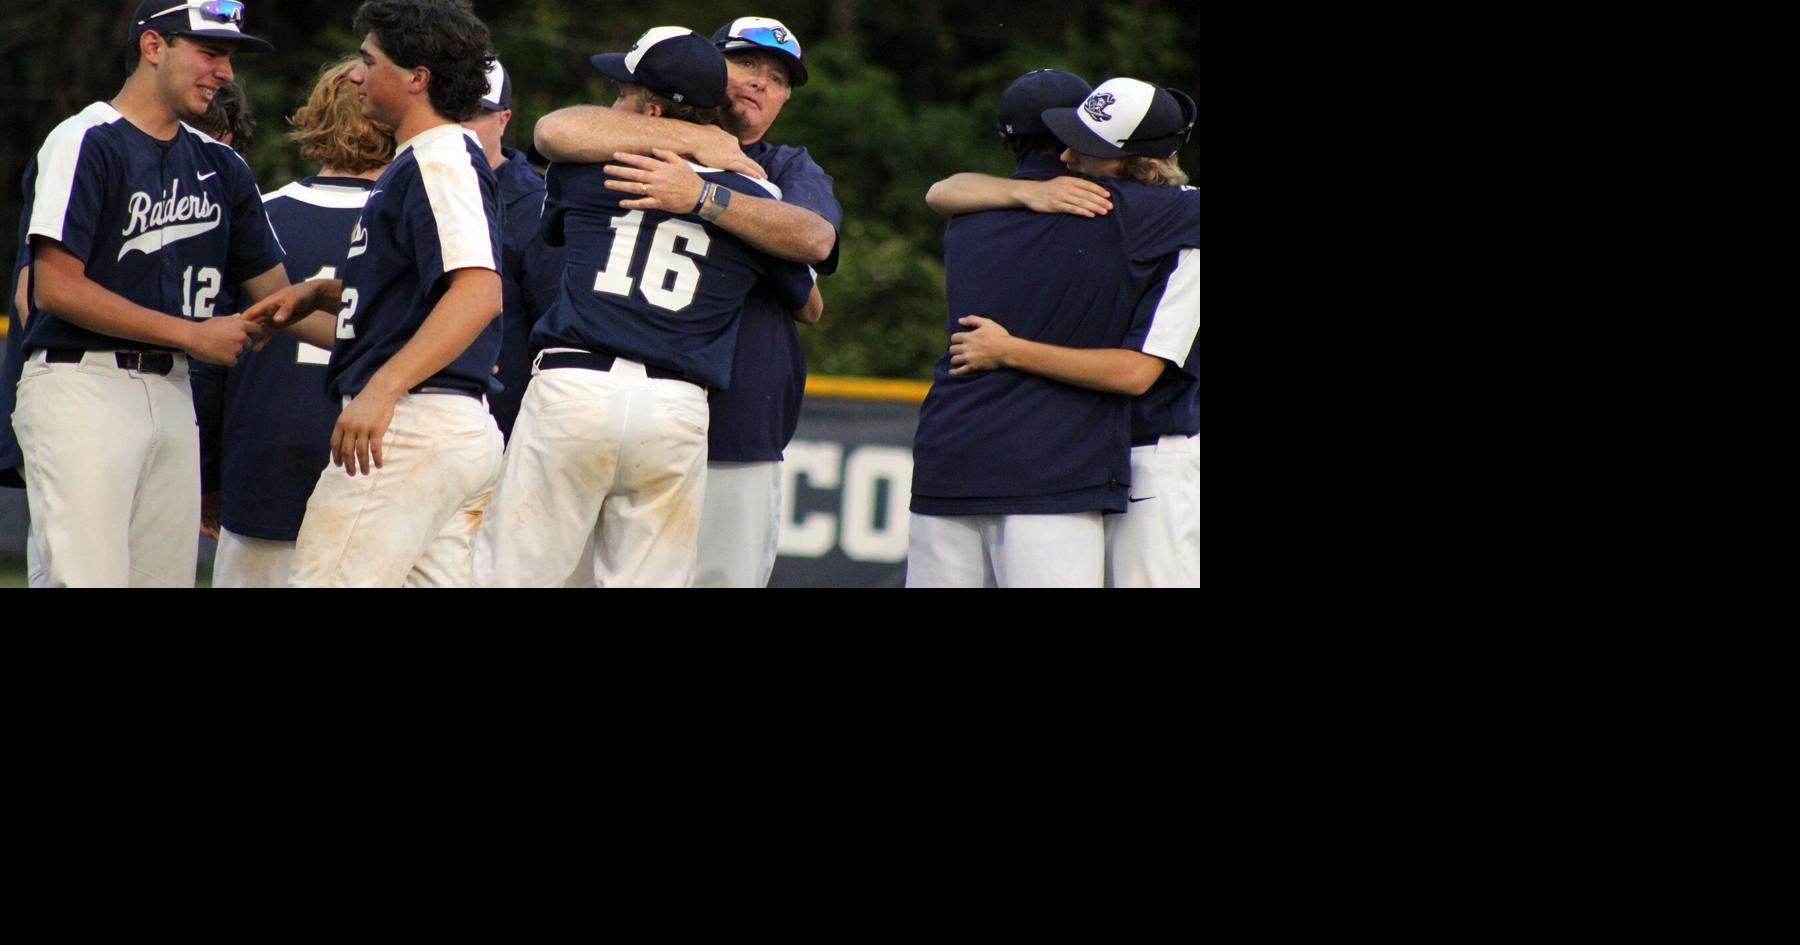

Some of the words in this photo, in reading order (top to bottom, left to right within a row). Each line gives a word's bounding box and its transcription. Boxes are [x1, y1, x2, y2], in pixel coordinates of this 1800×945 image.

[122, 178, 221, 236] Raiders
[182, 265, 221, 318] 12
[593, 209, 710, 311] 16
[777, 441, 914, 563] CO
